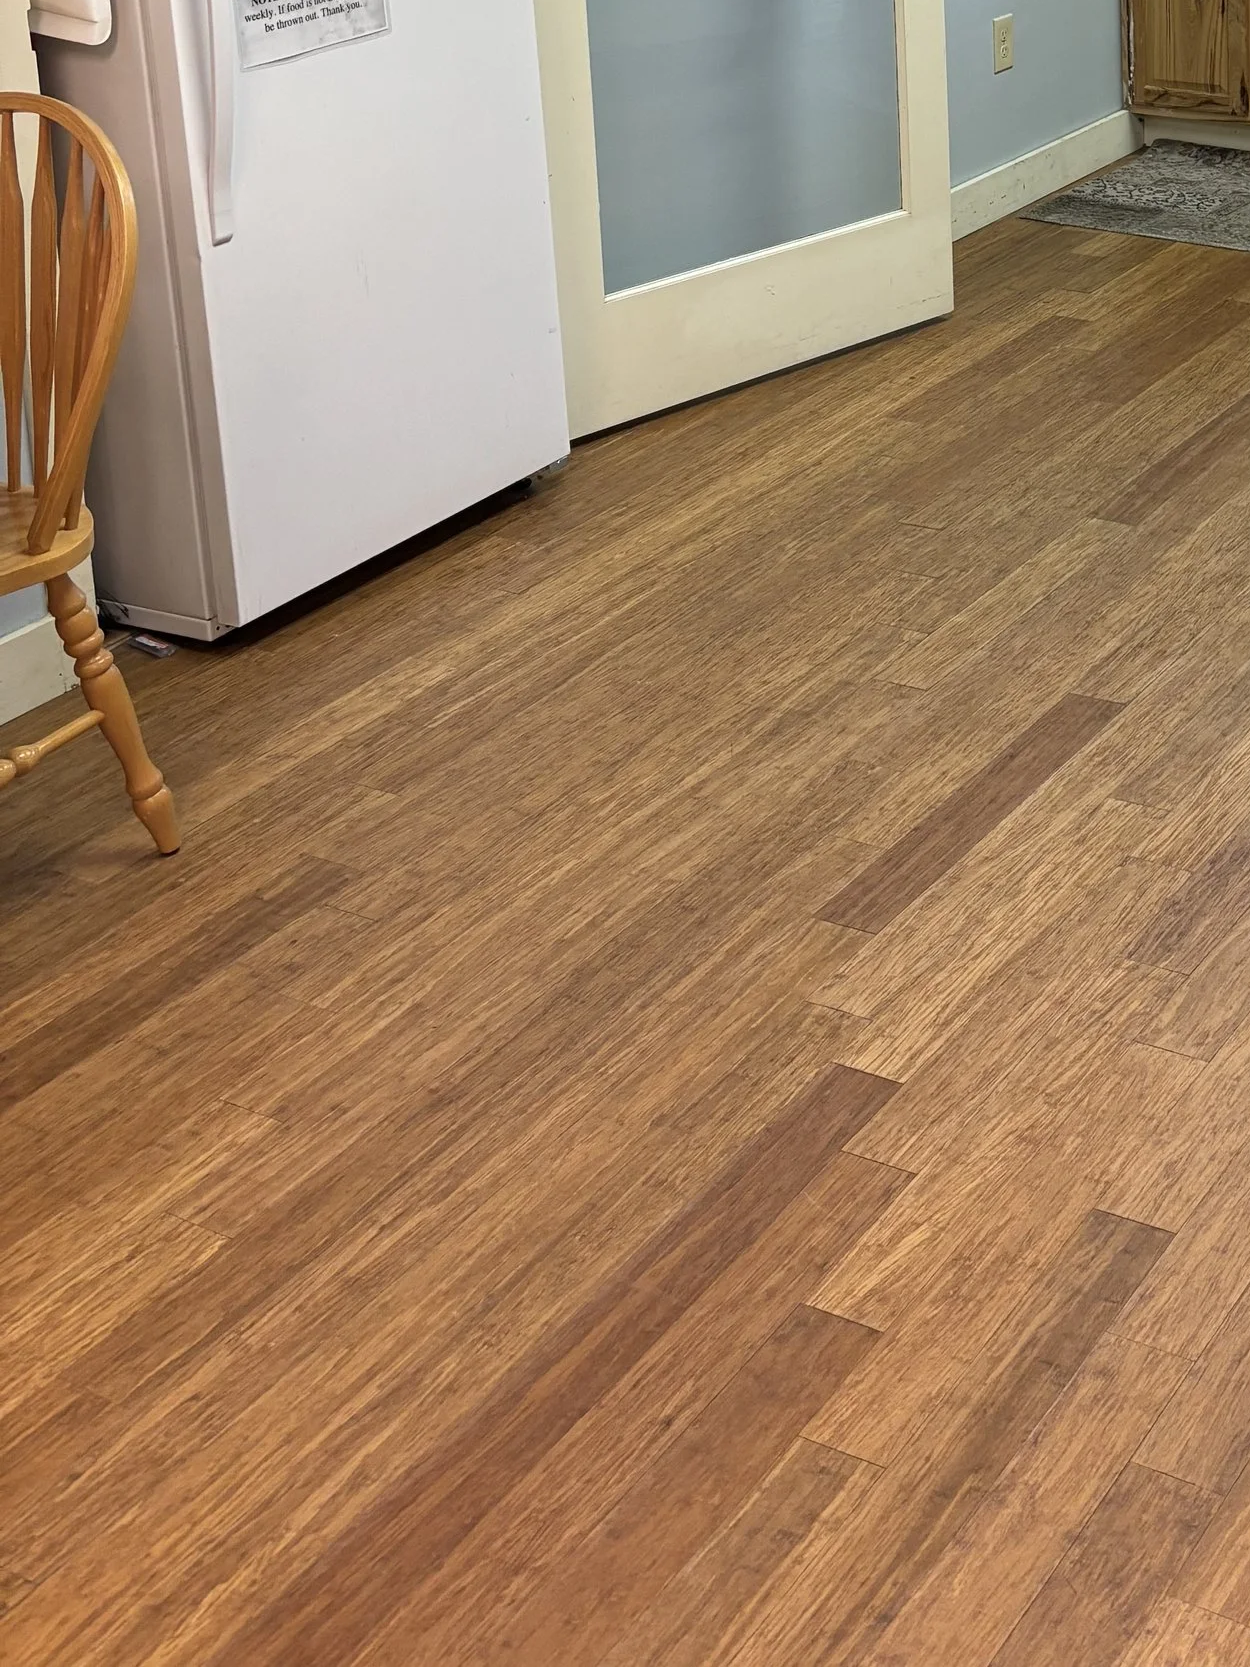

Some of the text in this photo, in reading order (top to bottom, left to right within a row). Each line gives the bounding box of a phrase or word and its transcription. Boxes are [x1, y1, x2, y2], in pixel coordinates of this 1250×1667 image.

[245, 8, 277, 23] weekly.
[278, 4, 285, 15] If
[287, 0, 304, 13] food
[306, 0, 313, 7] is
[265, 1, 363, 33] be thrown out. Thank you.
